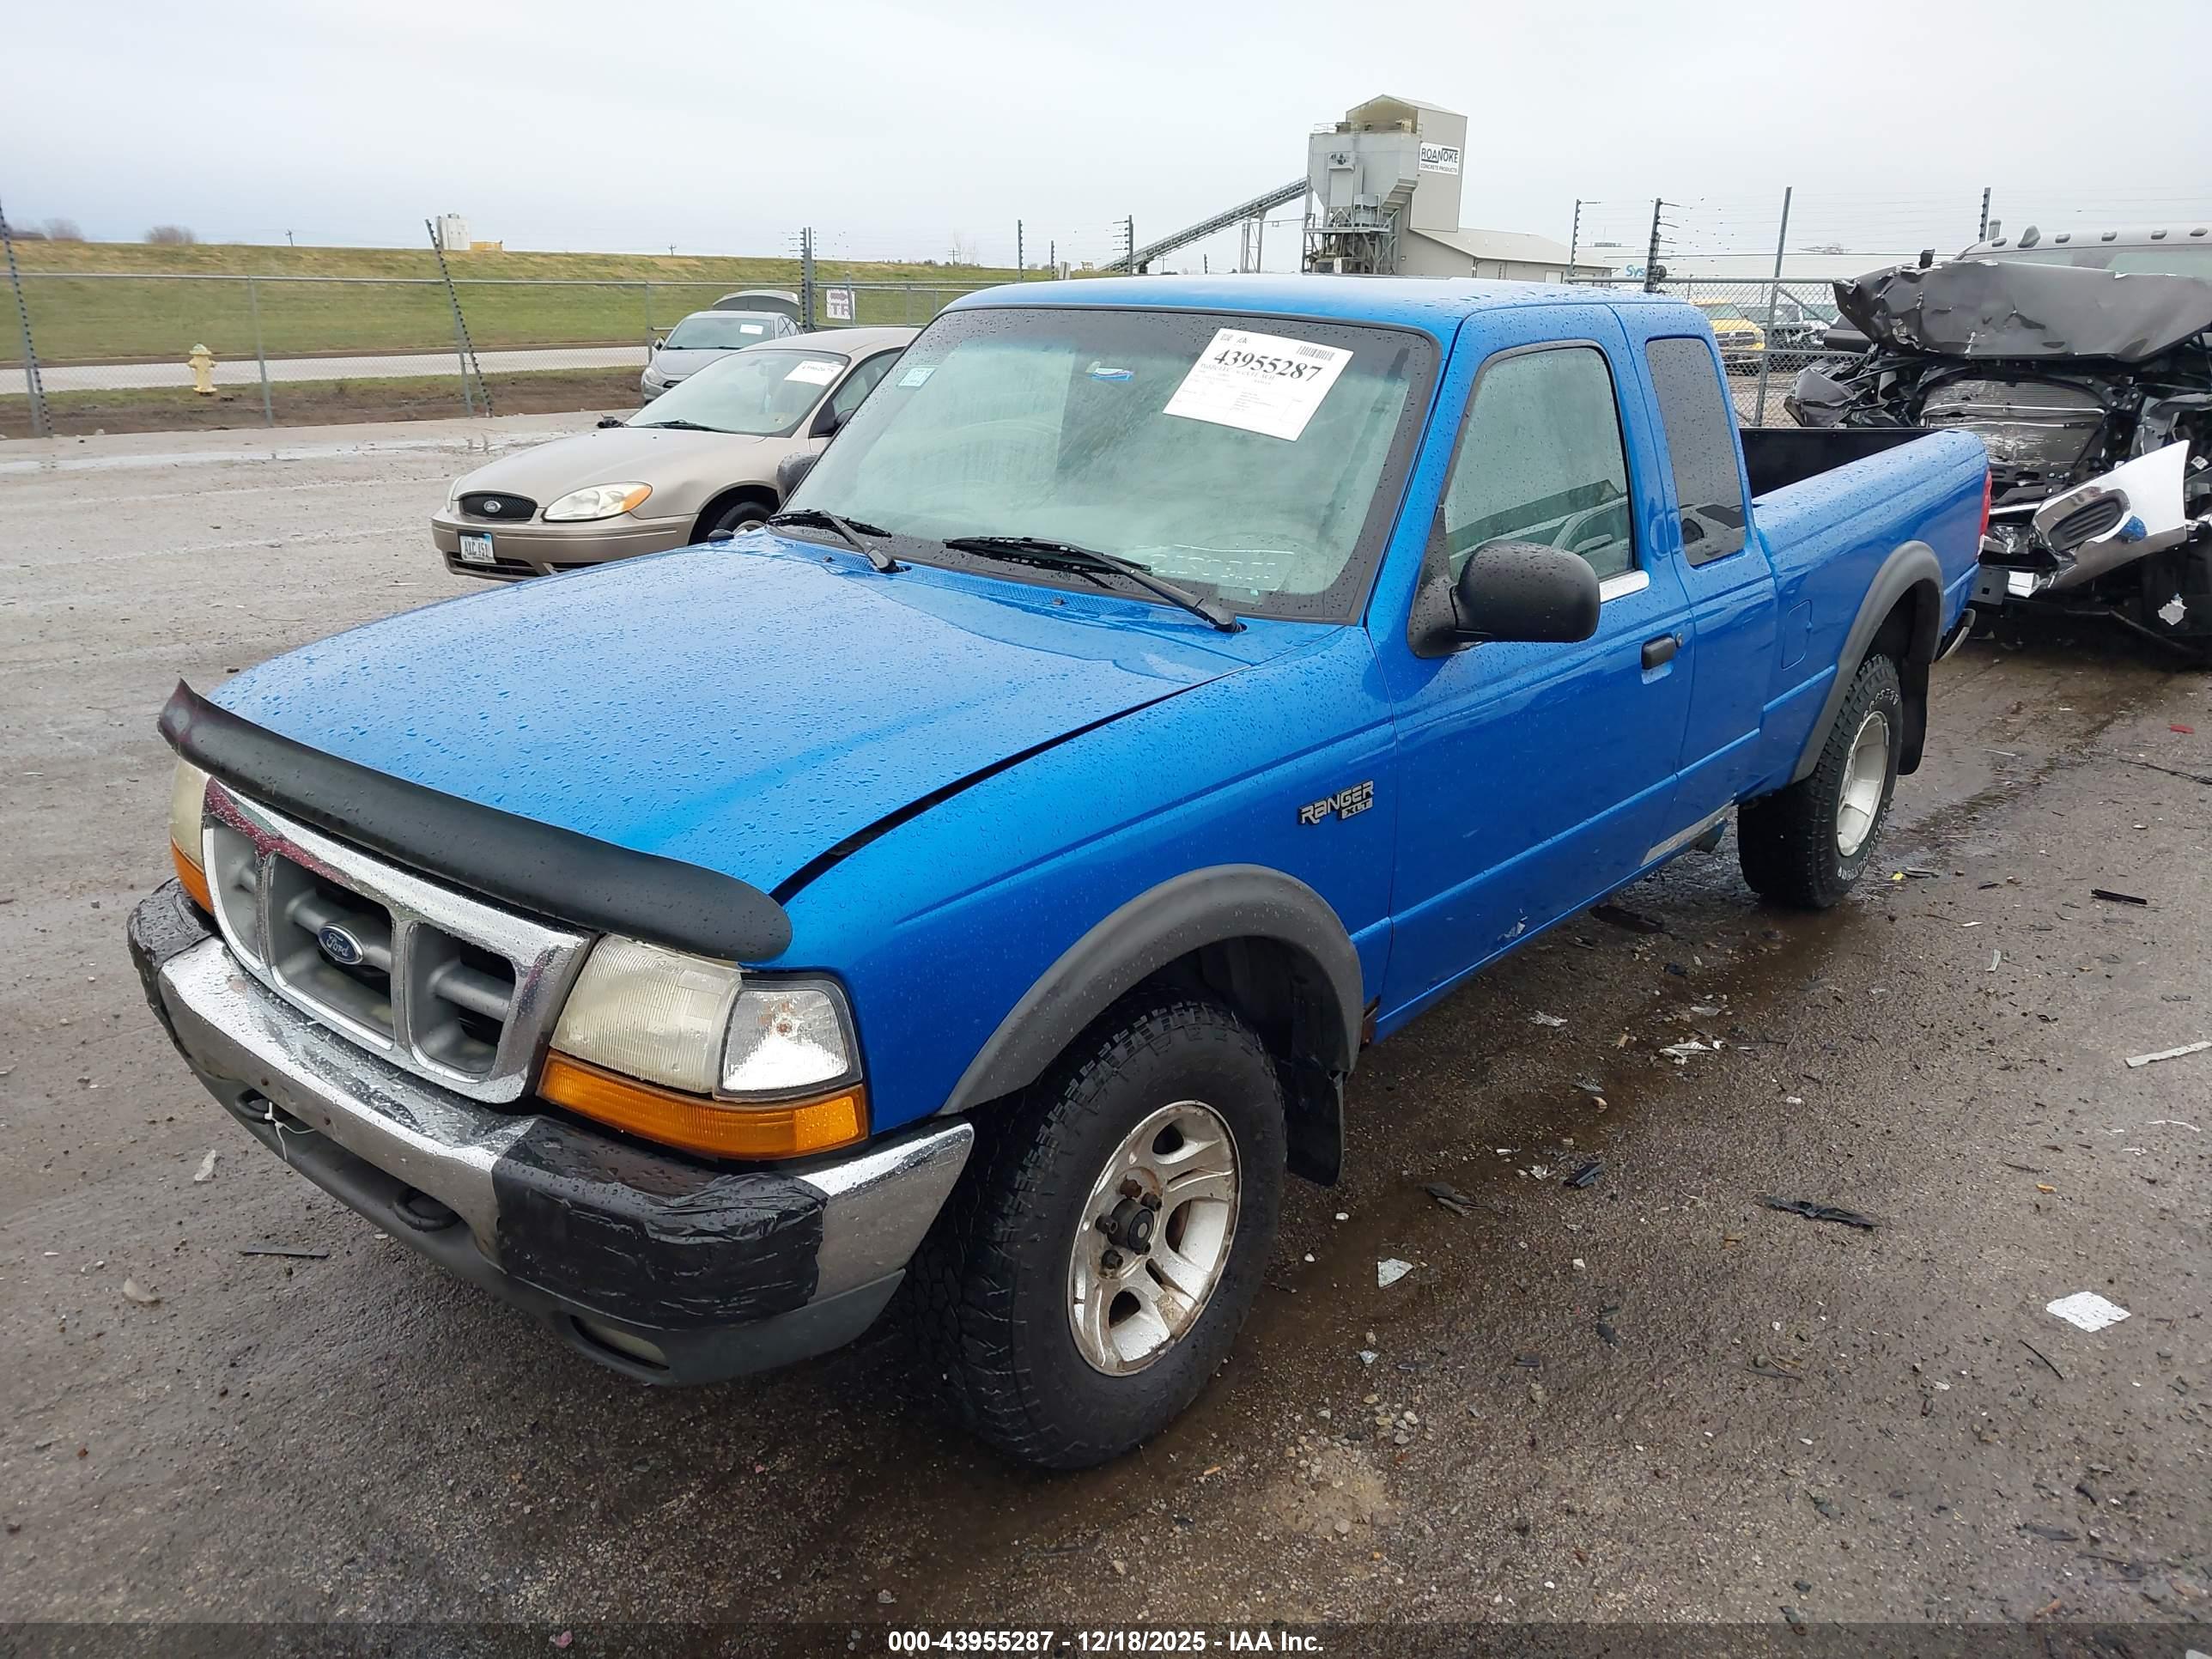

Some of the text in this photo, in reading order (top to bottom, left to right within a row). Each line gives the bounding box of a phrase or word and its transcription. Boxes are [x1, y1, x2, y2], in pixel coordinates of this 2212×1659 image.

[1421, 148, 1459, 164] ROANOKE
[1626, 264, 1647, 277] Sys
[1213, 349, 1324, 382] 43955287
[1299, 780, 1374, 824] RANGER
[1344, 799, 1372, 817] XLT
[325, 932, 349, 957] Ford
